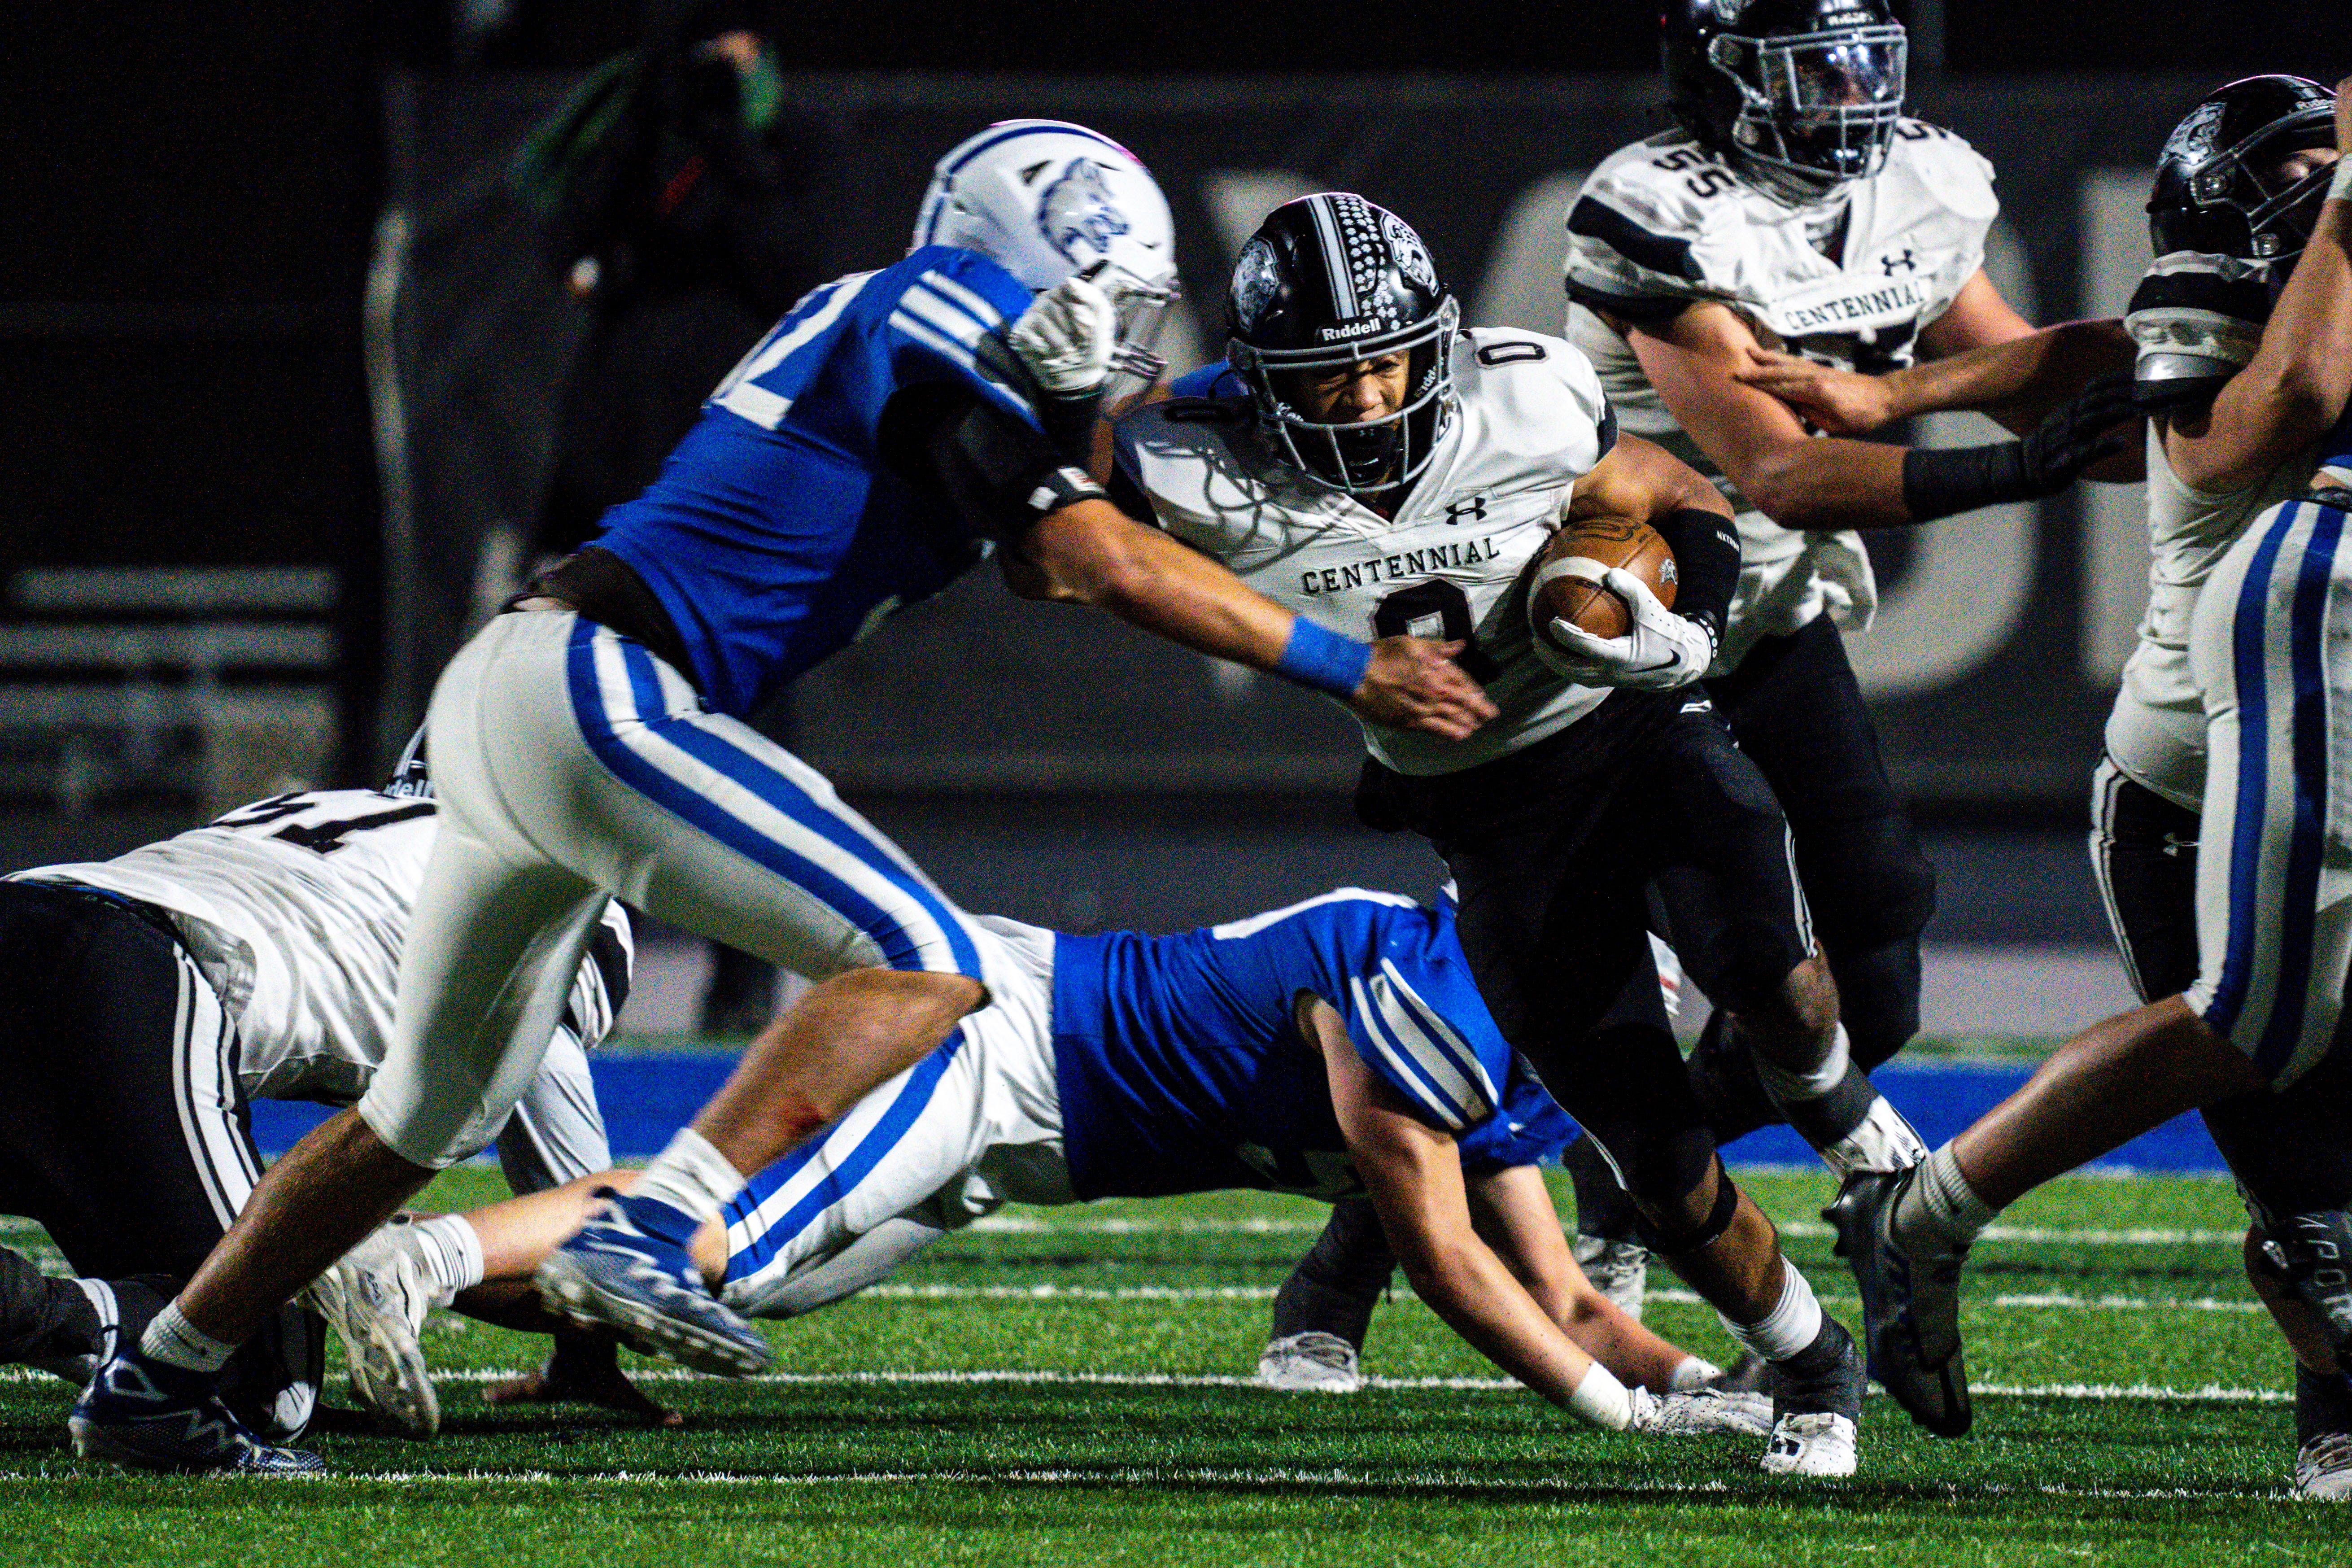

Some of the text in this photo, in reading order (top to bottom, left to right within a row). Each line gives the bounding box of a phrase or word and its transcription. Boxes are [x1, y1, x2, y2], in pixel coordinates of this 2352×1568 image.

[1653, 150, 1736, 197] 55
[1785, 281, 1925, 330] CENTENNIAL
[1321, 318, 1381, 341] Riddell
[1477, 341, 1547, 366] 0
[1302, 538, 1500, 593] CENTENNIAL
